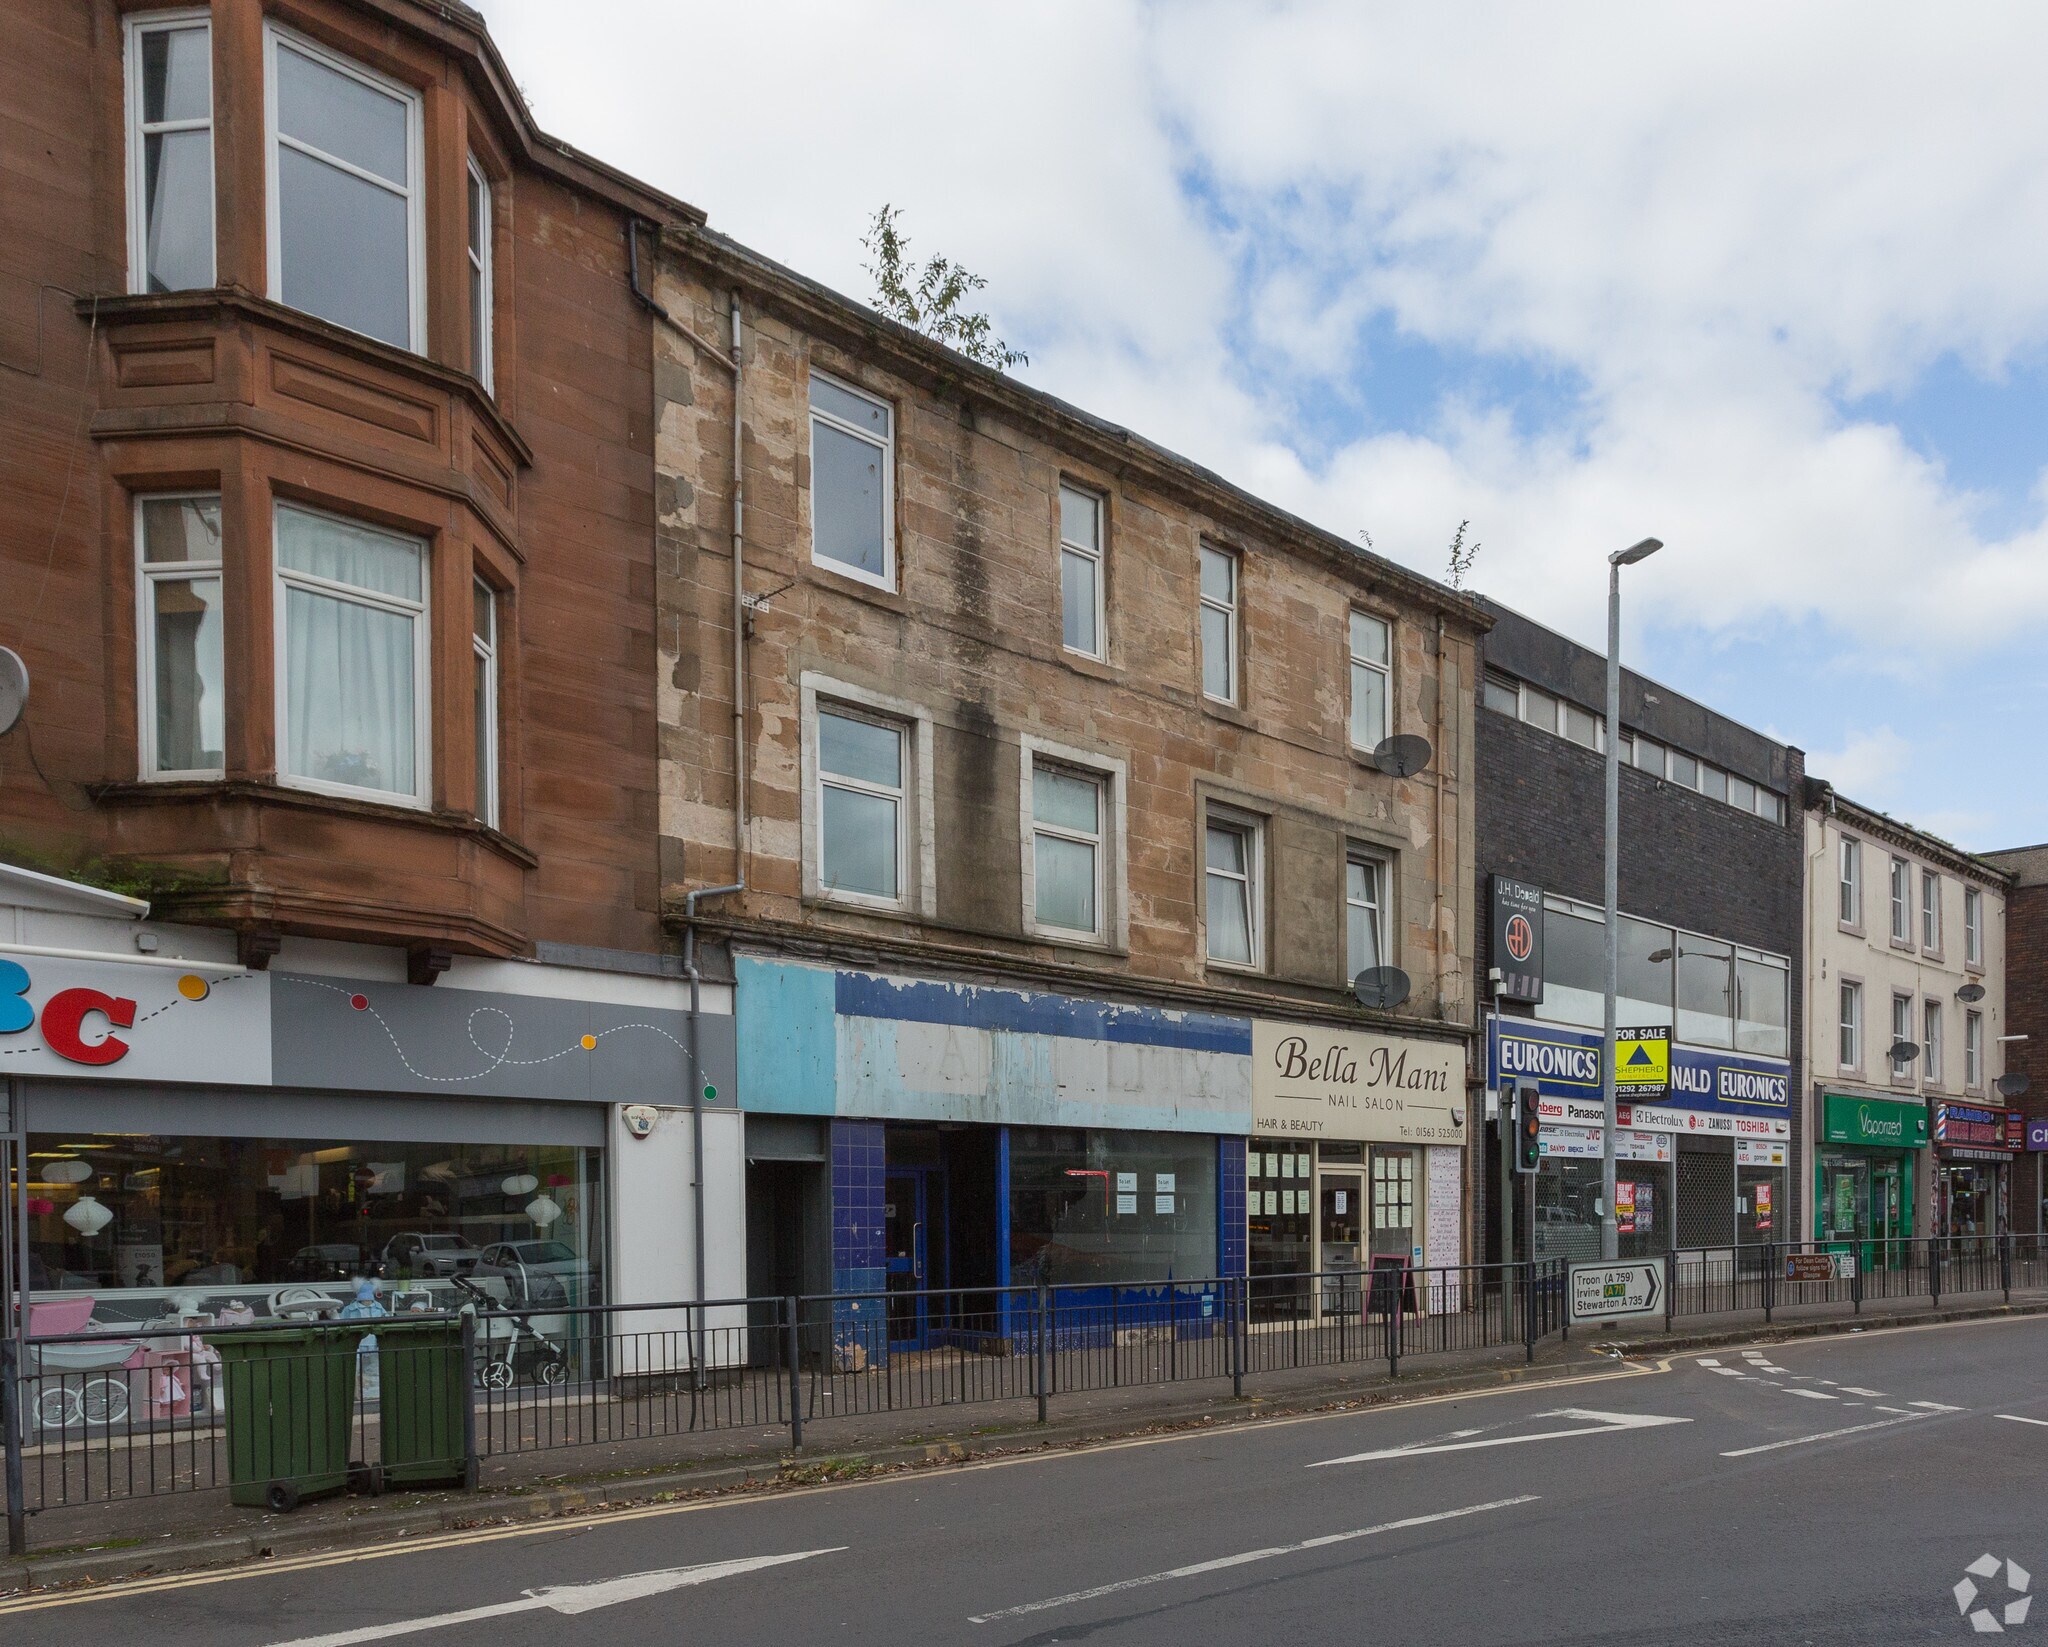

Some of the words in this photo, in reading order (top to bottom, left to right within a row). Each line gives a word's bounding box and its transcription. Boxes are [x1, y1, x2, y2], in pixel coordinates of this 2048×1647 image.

[1616, 1029, 1636, 1040] FOR
[1640, 1028, 1666, 1039] SALE
[1275, 1036, 1358, 1084] Bella
[1367, 1047, 1448, 1092] Mani
[1502, 1040, 1596, 1080] EURONICS
[1616, 1066, 1664, 1074] SHEPHERD
[1671, 1064, 1711, 1093] NALD
[1638, 1084, 1666, 1092] 267987
[1720, 1071, 1786, 1102] EURONICS
[1328, 1094, 1357, 1108] NAIL
[1365, 1097, 1403, 1111] SALON
[1539, 1102, 1562, 1115] berg
[1568, 1105, 1604, 1120] Panason
[1619, 1111, 1630, 1119] AEG
[1950, 1107, 1991, 1123] RAMBO
[1257, 1118, 1278, 1130] HAIR
[1281, 1119, 1287, 1130] &
[1290, 1120, 1324, 1131] BEAUTY
[1645, 1112, 1683, 1127] Electrolux
[1708, 1118, 1732, 1130] ZANUSSI
[1400, 1126, 1412, 1136] Tel:
[1416, 1127, 1435, 1137] 01563
[1438, 1128, 1462, 1138] 525000
[1736, 1120, 1770, 1133] TOSHIBA
[1586, 1130, 1600, 1140] JVC
[1550, 1144, 1565, 1152] SANYO
[1577, 1276, 1600, 1285] Troon
[1616, 1272, 1634, 1283] 759)
[1577, 1288, 1600, 1298] Irvine
[1577, 1299, 1620, 1311] Stewarton
[1629, 1296, 1642, 1306] 735
